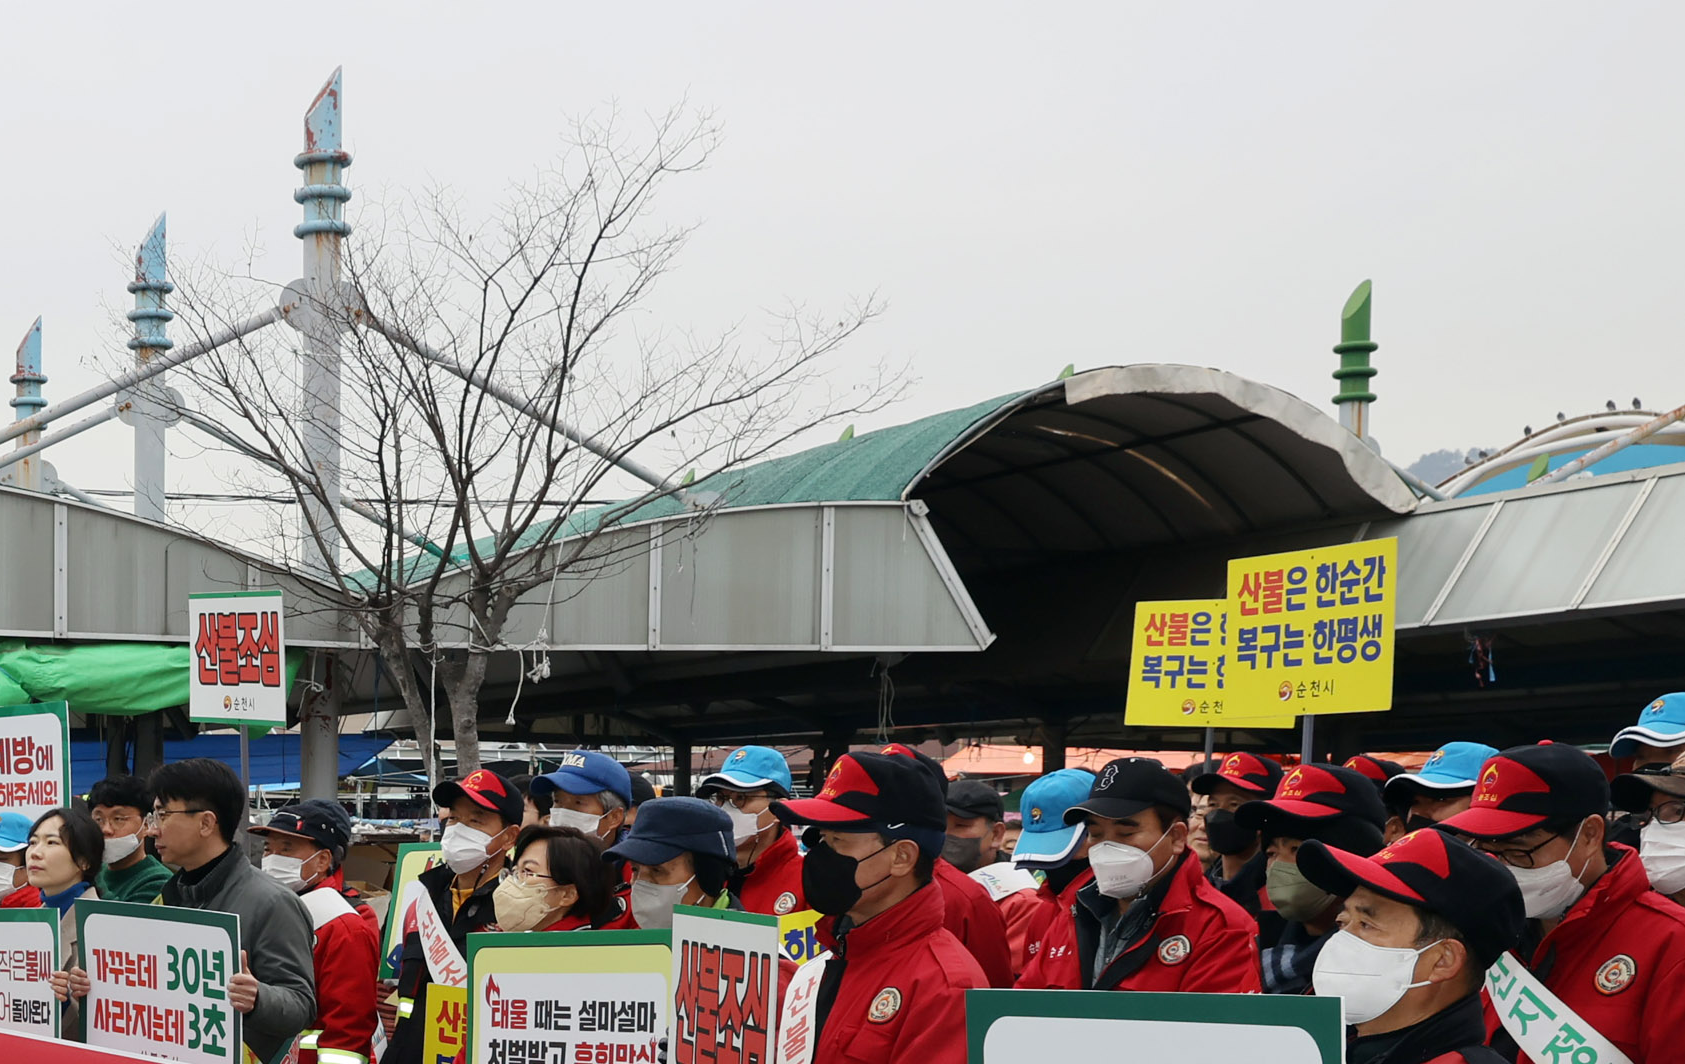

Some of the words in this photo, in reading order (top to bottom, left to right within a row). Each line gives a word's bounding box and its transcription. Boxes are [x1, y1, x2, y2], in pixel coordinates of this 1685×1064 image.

[1238, 566, 1308, 617] 산불은
[1315, 555, 1386, 609] 한순간
[1144, 611, 1213, 647] 산불은
[1237, 623, 1304, 670] 복구는
[1312, 614, 1383, 665] 한평생
[195, 611, 281, 688] 산불조심
[1141, 655, 1206, 689] 복구는
[1296, 679, 1335, 699] 순천시
[234, 696, 256, 711] 순천시
[92, 948, 157, 990] 가꾸는데
[166, 945, 226, 1000] 30년
[12, 999, 51, 1025] 돌아온다
[93, 998, 184, 1045] 사라지는데
[188, 1003, 226, 1057] 3초
[491, 999, 528, 1029] 태울
[534, 1000, 571, 1031] 때는
[578, 1000, 656, 1033] 설마설마
